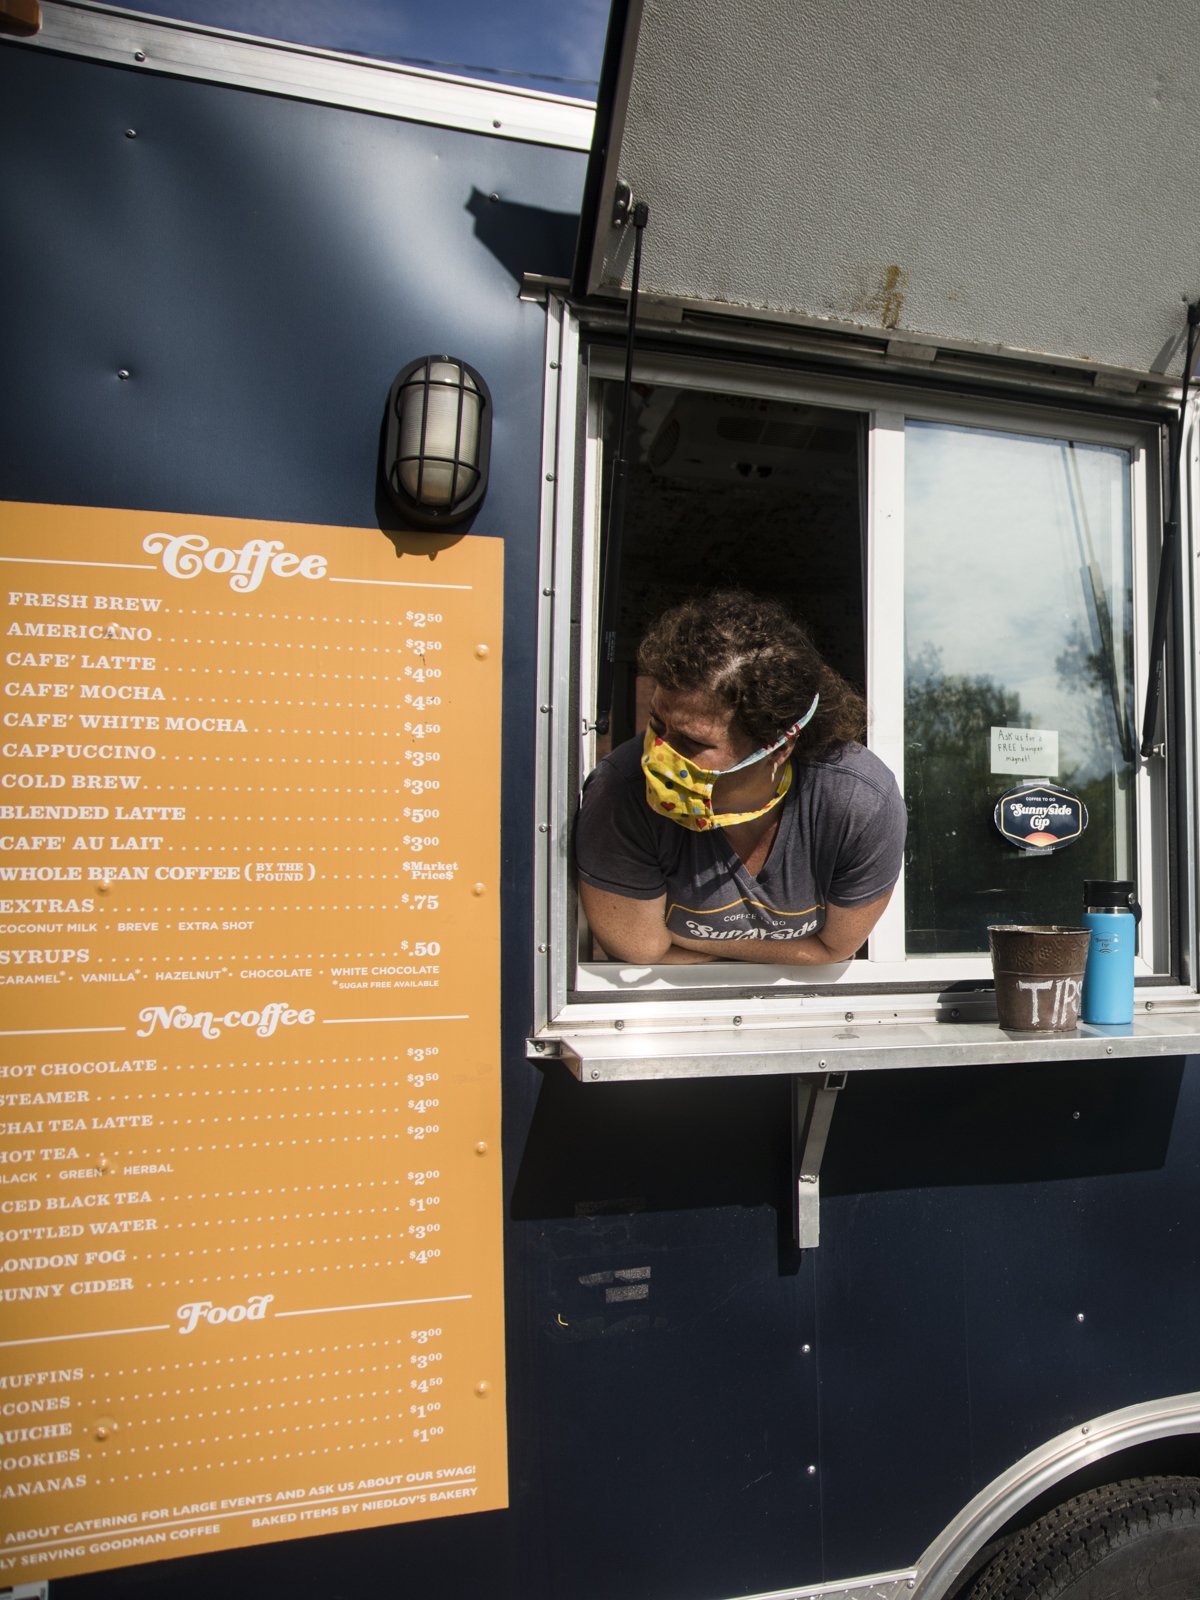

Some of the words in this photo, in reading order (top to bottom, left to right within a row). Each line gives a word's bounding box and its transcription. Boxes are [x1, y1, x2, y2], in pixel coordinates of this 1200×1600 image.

[141, 533, 327, 592] Coffee
[9, 592, 88, 608] FRESH
[94, 596, 162, 611] BREW
[6, 622, 152, 641] AMERICANO
[81, 655, 155, 670] LATTE
[80, 685, 165, 700] MOCHA
[79, 715, 159, 729] WHITE
[165, 717, 248, 732] MOCHA
[2, 744, 156, 759] CAPPUCCINO
[998, 743, 1017, 752] FREE
[1, 774, 65, 788] COLD
[72, 775, 141, 789] BREW
[0, 806, 108, 819] BLENDED
[115, 807, 185, 820] LATTE
[1010, 803, 1072, 818] Sunnyside
[1030, 815, 1050, 831] Cup
[72, 837, 104, 850] AU
[111, 837, 163, 850] LAIT
[0, 867, 81, 880] WHOLE
[88, 867, 149, 883] BEAN
[154, 867, 240, 880] COFFEE
[277, 862, 303, 871] THE
[0, 899, 94, 913] EXTRAS
[0, 924, 63, 933] COCONUT
[67, 923, 96, 932] MILK
[117, 922, 158, 931] BREVE
[178, 922, 218, 930] EXTRA
[222, 922, 254, 930] SHOT
[0, 949, 89, 964] SYRUPS
[240, 968, 312, 978] CHOCOLATE
[331, 967, 368, 976] WHITE
[371, 966, 439, 975] CHOCOLATE
[136, 1003, 315, 1039] Non-coffee
[40, 1060, 157, 1075] CHOCOLATE
[49, 1119, 87, 1132] TEA
[92, 1115, 152, 1129] LATTE
[40, 1148, 79, 1160] TEA
[0, 1173, 37, 1184] LACK
[59, 1168, 103, 1180] GREEN
[123, 1164, 173, 1175] HERBAL
[0, 1199, 41, 1213] CED
[46, 1194, 110, 1210] BLACK
[114, 1191, 152, 1204] TEA
[89, 1219, 157, 1235] WATER
[0, 1254, 78, 1272] ONDON
[85, 1250, 126, 1264] FOG
[0, 1284, 64, 1301] UNNY
[70, 1278, 133, 1295] CIDER
[176, 1294, 274, 1334] Food
[0, 1396, 70, 1416] CONES
[0, 1449, 80, 1470] OOKIES
[0, 1475, 86, 1498] ANANAS
[5, 1526, 60, 1544] ABOUT
[64, 1513, 138, 1533] CATERING
[141, 1509, 169, 1521] FOR
[173, 1501, 217, 1516] LARGE
[220, 1494, 272, 1509] EVENTS
[275, 1489, 305, 1501] AND
[309, 1485, 333, 1496] ASK
[337, 1482, 354, 1492] US
[358, 1475, 403, 1489] ABOUT
[406, 1472, 433, 1482] OUR
[436, 1466, 475, 1478] SWAG!
[21, 1546, 85, 1564] SERVING
[89, 1533, 166, 1554] GOODMAN
[170, 1524, 220, 1540] COFFEE
[252, 1513, 296, 1528] BAKED
[300, 1507, 338, 1520] ITEMS
[342, 1504, 358, 1514] BY
[362, 1495, 426, 1511] NIEDLOV'S
[429, 1487, 477, 1502] BAKERY
